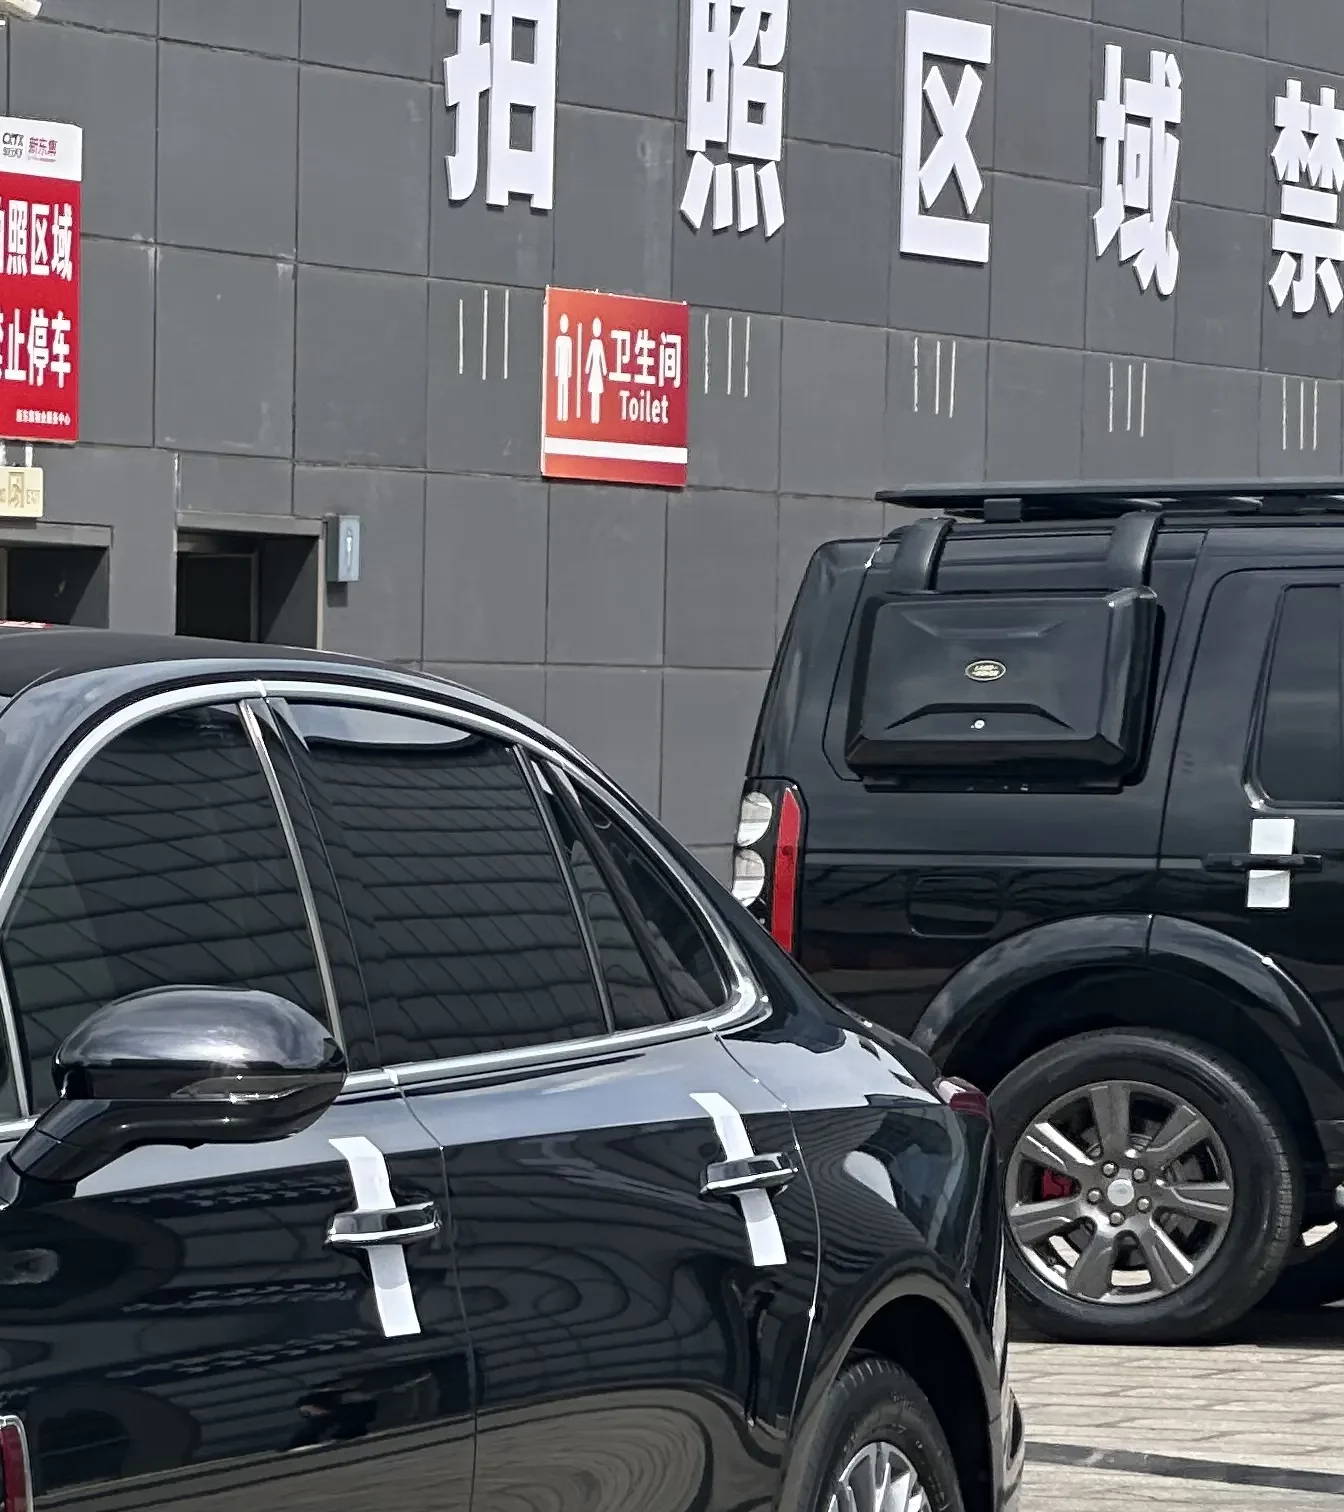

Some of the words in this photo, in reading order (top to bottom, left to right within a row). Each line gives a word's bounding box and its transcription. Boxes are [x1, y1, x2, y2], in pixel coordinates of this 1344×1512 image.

[608, 328, 682, 389] 卫生间
[618, 390, 669, 424] Toilet
